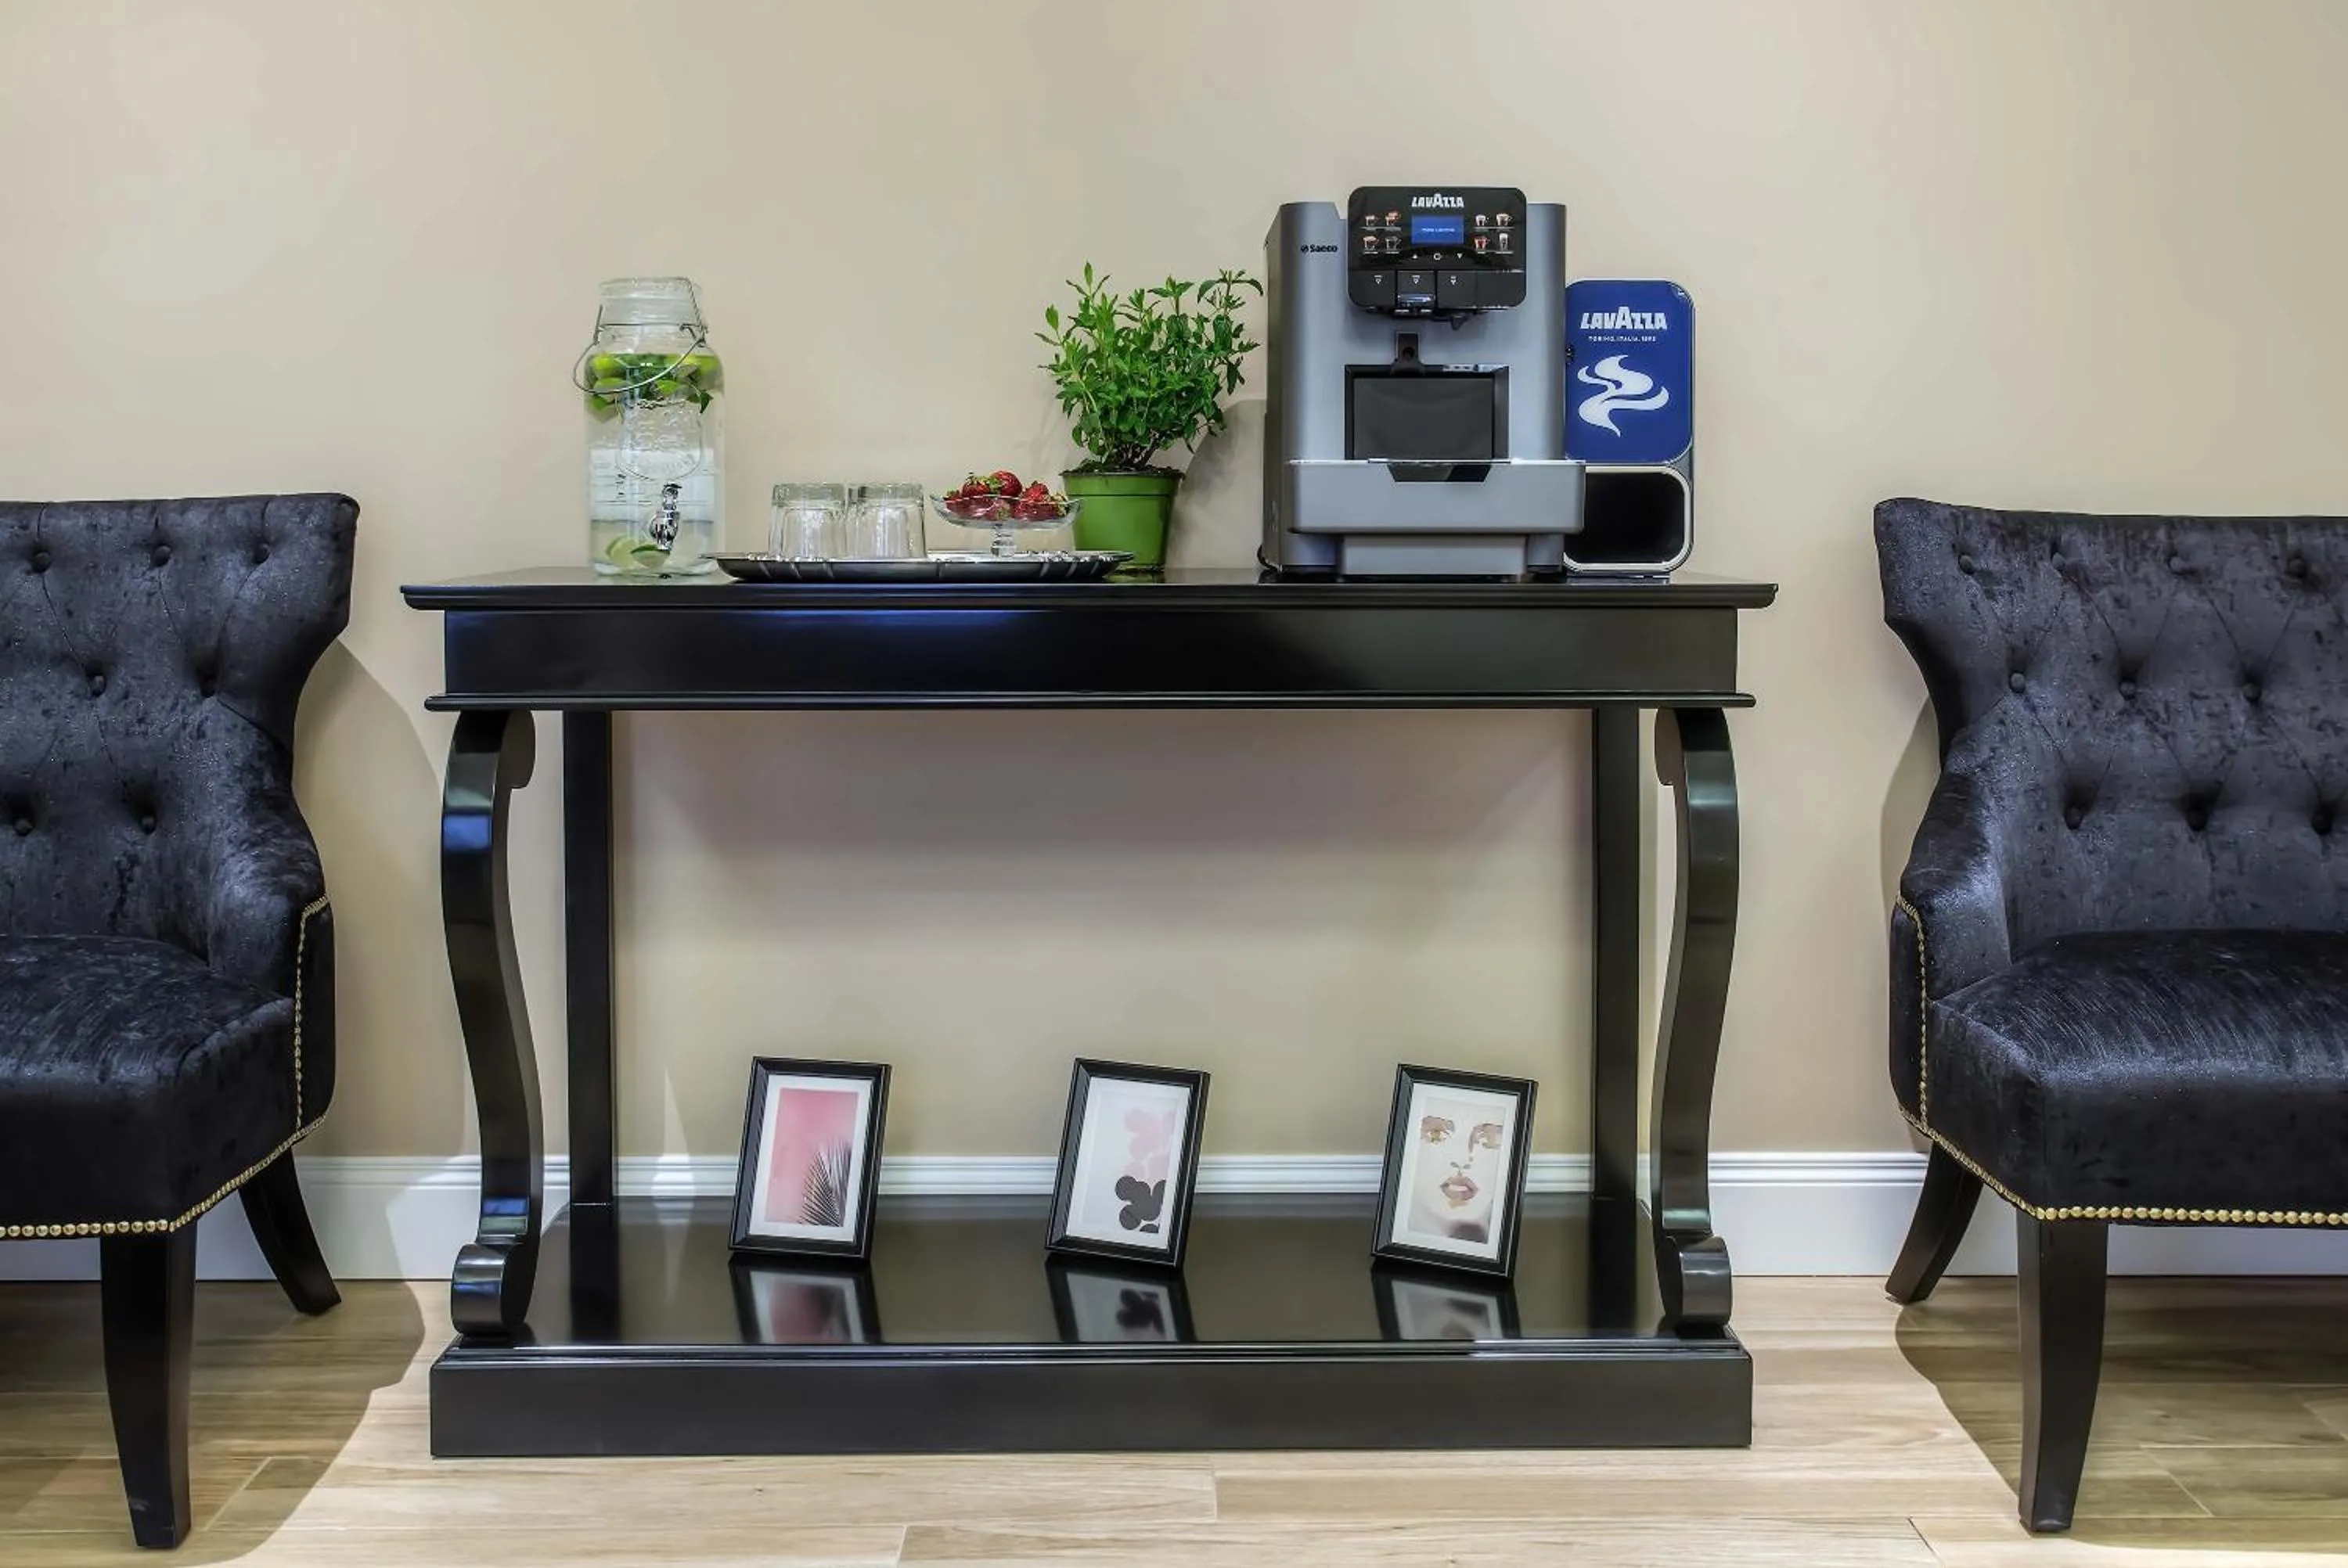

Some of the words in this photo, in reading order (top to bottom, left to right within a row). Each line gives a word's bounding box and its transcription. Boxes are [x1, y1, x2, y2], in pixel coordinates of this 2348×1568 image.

[1411, 193, 1464, 208] LAVAZZA
[1309, 244, 1338, 253] Saeco
[1580, 306, 1667, 330] LAVAZZA
